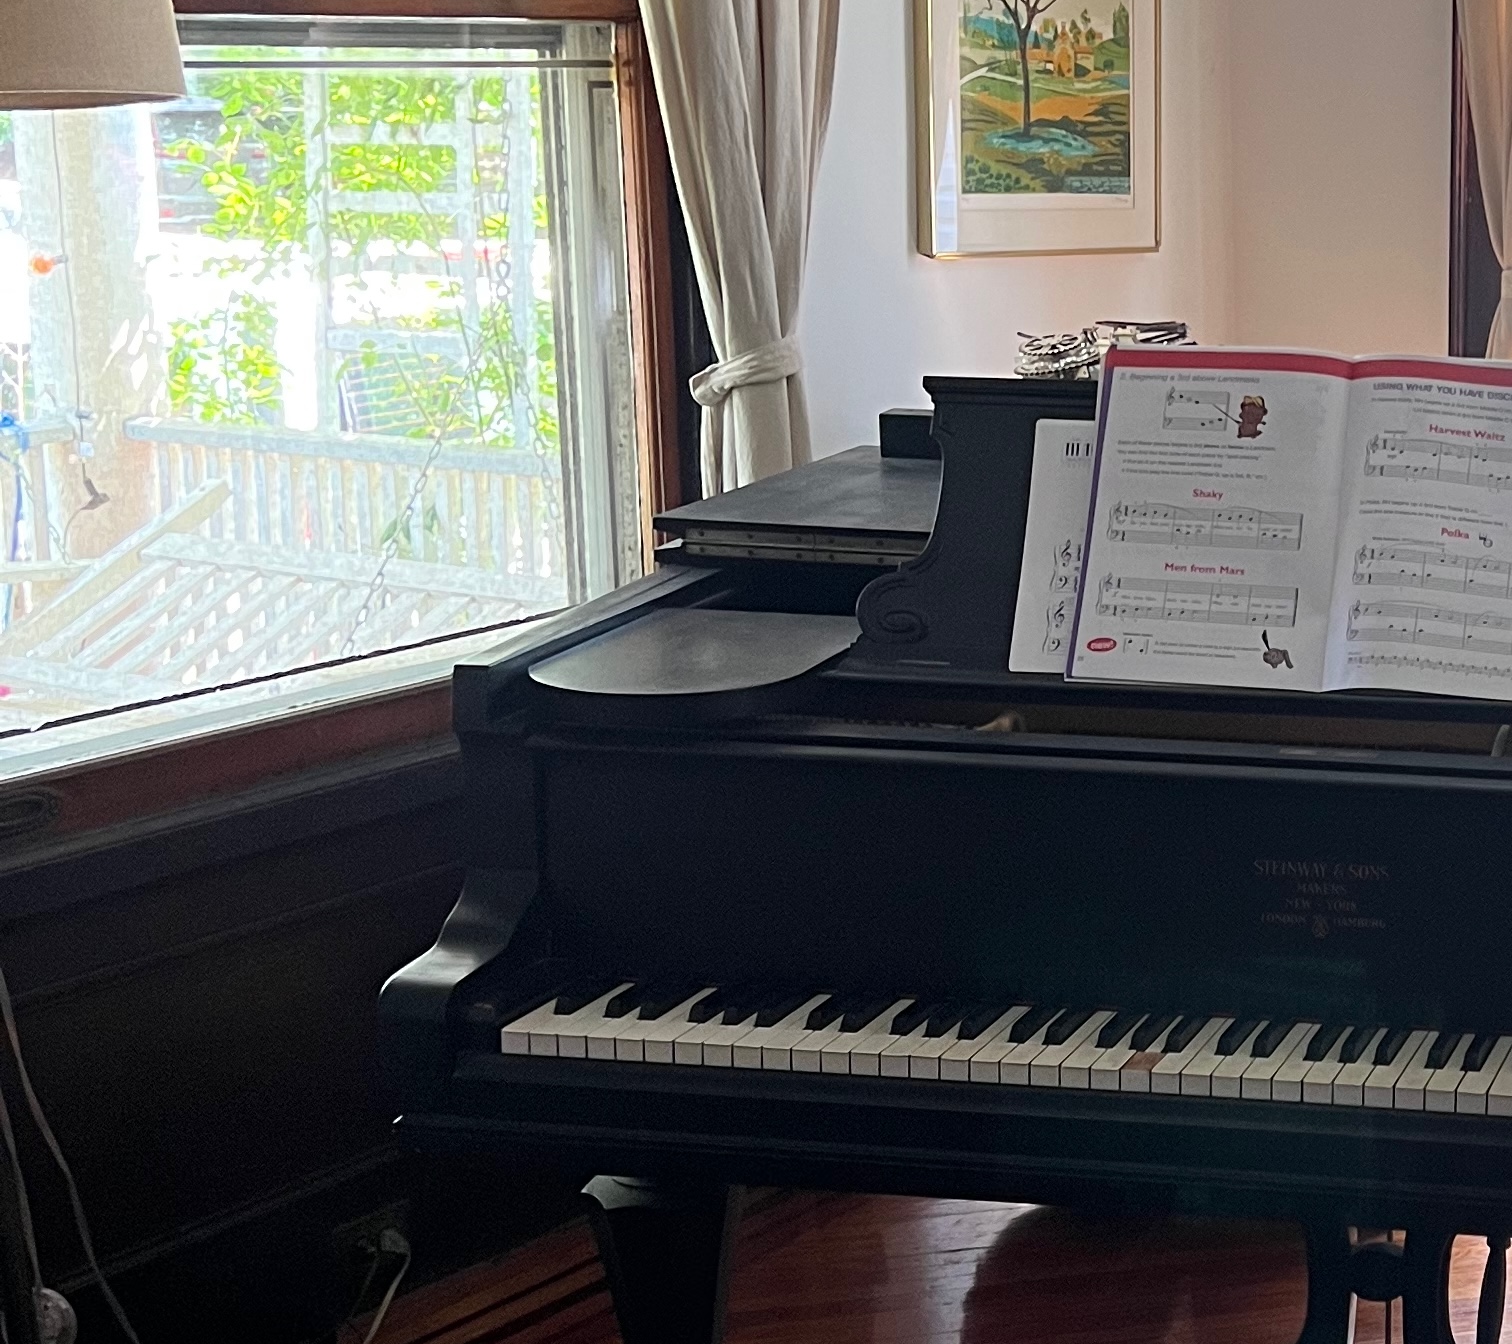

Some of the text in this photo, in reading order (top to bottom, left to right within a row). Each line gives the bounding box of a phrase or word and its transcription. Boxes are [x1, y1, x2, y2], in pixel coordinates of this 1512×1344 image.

[1372, 382, 1404, 392] USING
[1405, 383, 1434, 394] WHAT
[1436, 385, 1457, 396] YOU
[1459, 387, 1484, 400] HAVE
[1428, 423, 1506, 442] Harvest Waltz
[1192, 488, 1224, 502] Shaky
[1440, 526, 1470, 540] Polka
[1164, 562, 1246, 577] Men from Mars
[1253, 859, 1326, 878] STEINWAY
[1347, 864, 1390, 881] SONS
